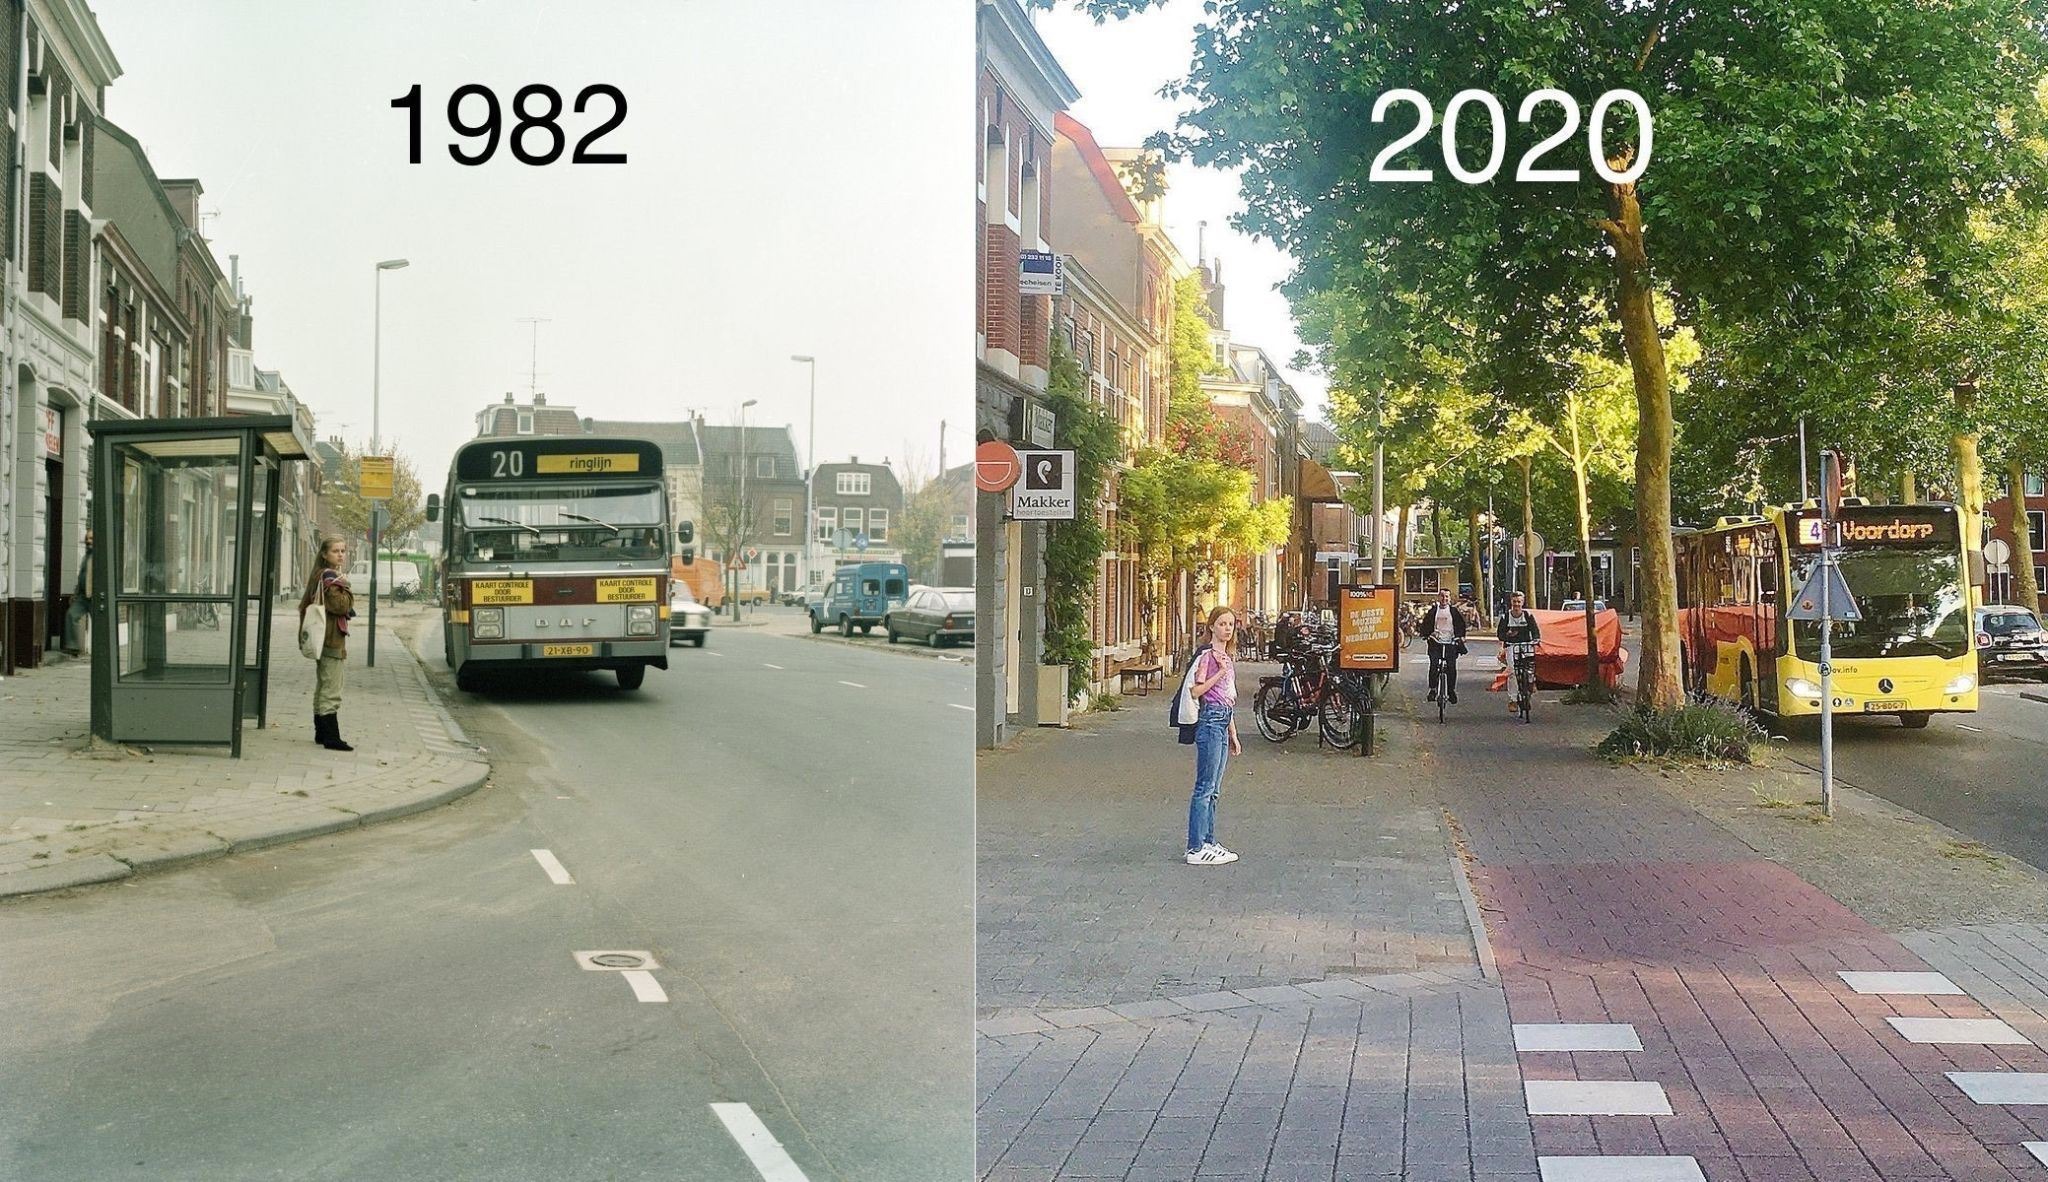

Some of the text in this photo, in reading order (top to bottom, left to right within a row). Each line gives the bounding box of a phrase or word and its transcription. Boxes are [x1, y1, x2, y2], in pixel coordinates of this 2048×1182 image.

[1055, 281, 1062, 292] TE
[493, 451, 612, 477] 20 ringlijn
[1017, 496, 1071, 508] Makker
[1810, 522, 1820, 540] 4
[1842, 519, 1934, 540] Voordorp
[475, 581, 497, 589] KAART
[1361, 608, 1385, 617] BESTE
[1359, 625, 1376, 633] VAN
[1345, 631, 1389, 643] NEDERLAND
[547, 646, 589, 655] 21-XB-90
